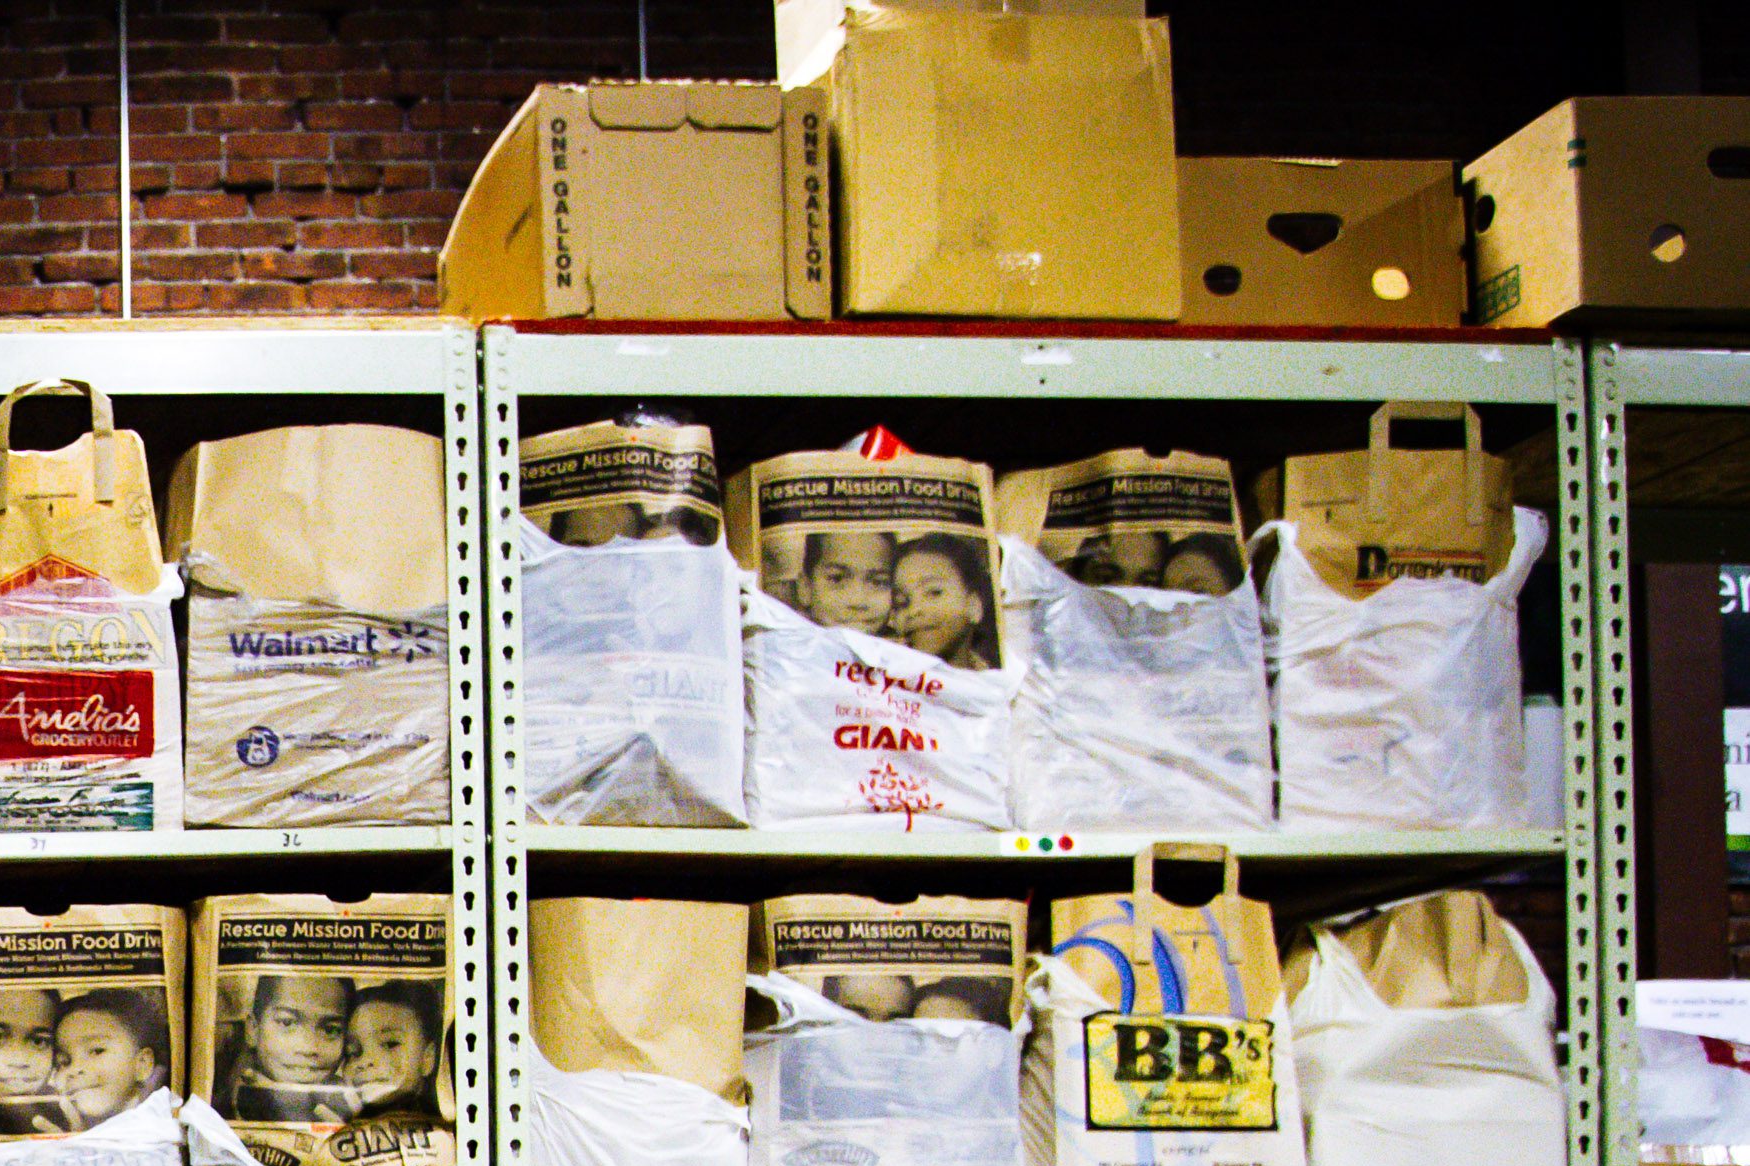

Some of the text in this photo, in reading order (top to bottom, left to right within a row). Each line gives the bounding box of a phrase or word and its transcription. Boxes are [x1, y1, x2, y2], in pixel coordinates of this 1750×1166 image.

[551, 117, 572, 288] ONE GALLON
[803, 112, 822, 283] ONE GALLON
[521, 450, 699, 479] Rescue Mission Food
[761, 481, 829, 500] Rescue
[833, 478, 900, 496] Mission
[903, 479, 944, 497] Food
[229, 627, 378, 657] Walmart
[835, 660, 943, 695] recycle
[72, 933, 120, 949] Food
[221, 922, 287, 938] Rescue
[292, 922, 364, 938] Mission
[370, 923, 419, 939] Food
[778, 922, 1011, 941] Rescue Mission Food Drive
[1113, 1023, 1261, 1082] BB's
[330, 1120, 434, 1162] GIANT
